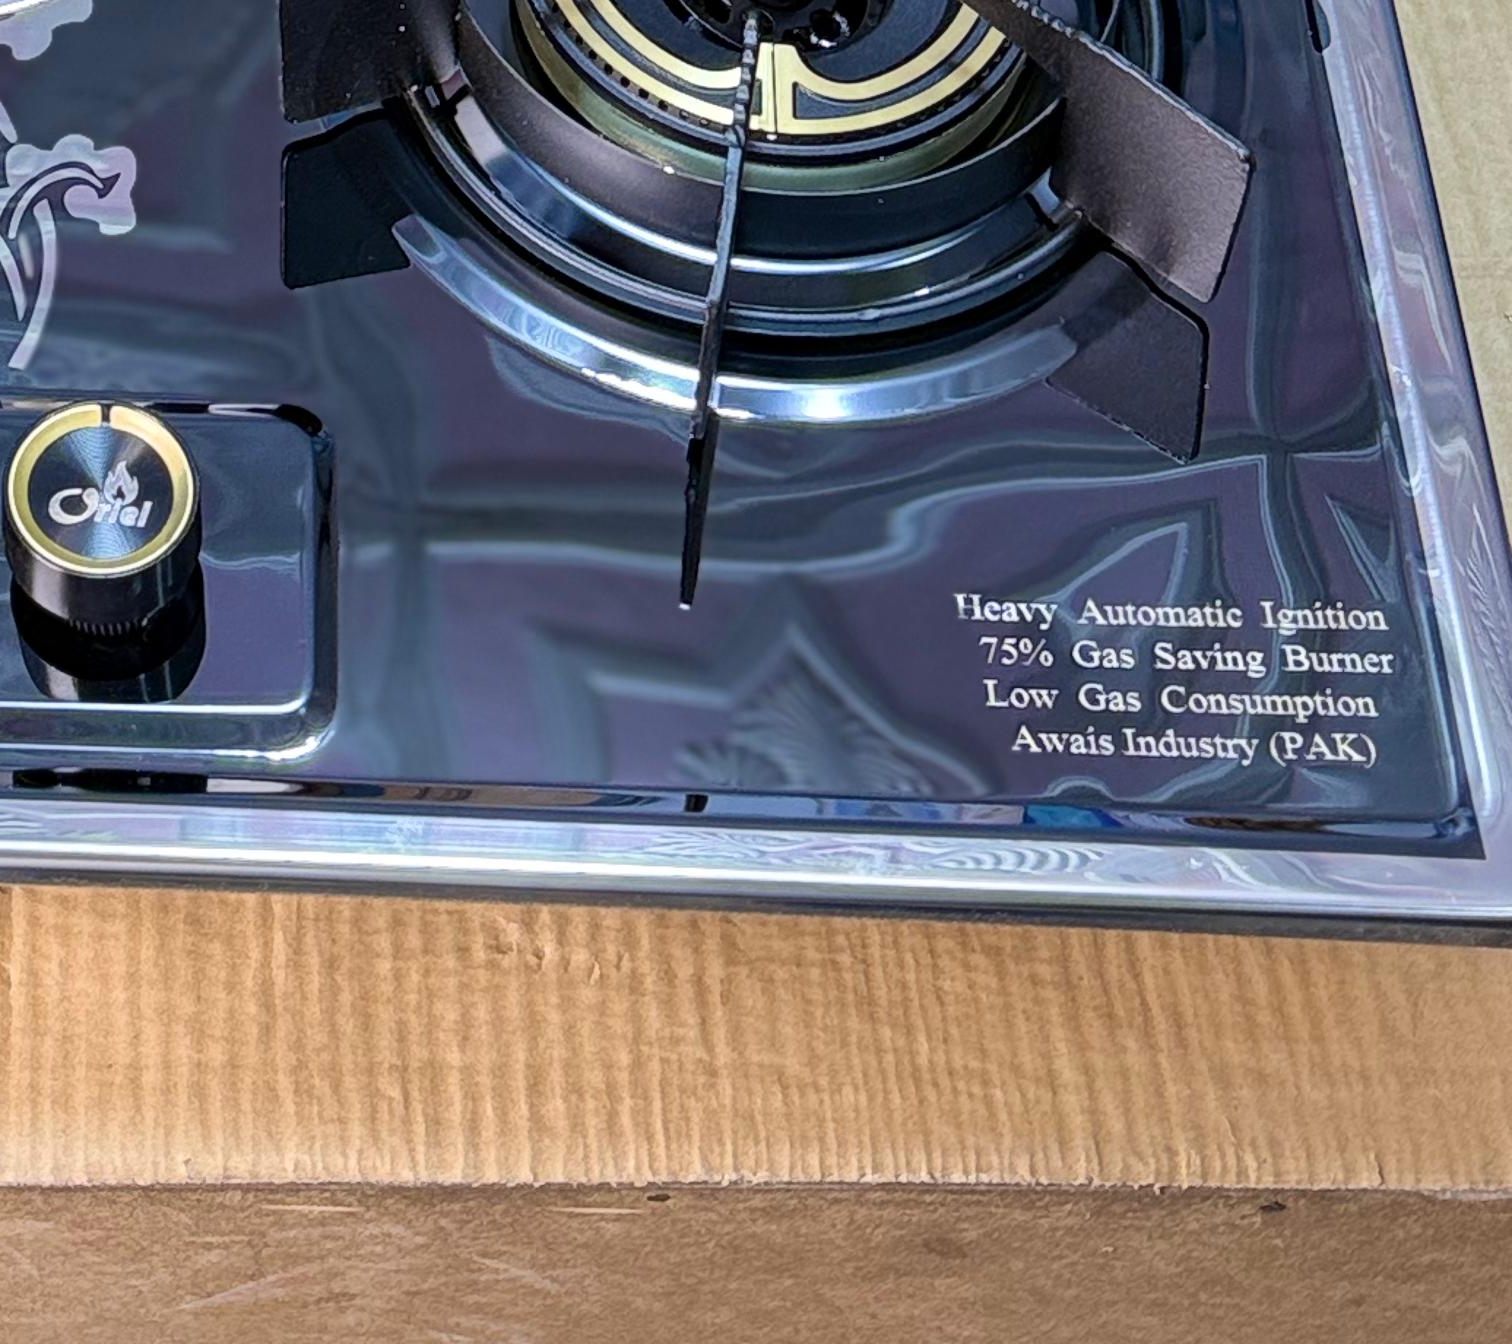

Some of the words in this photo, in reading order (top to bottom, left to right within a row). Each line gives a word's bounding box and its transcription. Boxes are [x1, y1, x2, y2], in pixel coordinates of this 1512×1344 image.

[48, 487, 154, 529] Oriel
[954, 593, 1057, 630] Heavy
[1076, 599, 1243, 629] Automatic
[1260, 600, 1389, 636] Ignition
[979, 636, 1054, 668] 75%
[1072, 640, 1135, 670] Gas
[1154, 643, 1266, 677] Saving
[1281, 644, 1395, 675] Burner
[983, 678, 1059, 710] Low
[1078, 683, 1142, 713] Gas
[1160, 685, 1380, 724] Consumption
[1011, 725, 1115, 757] Awais
[1121, 727, 1260, 766] Industry
[1268, 731, 1377, 769] (PAK)
